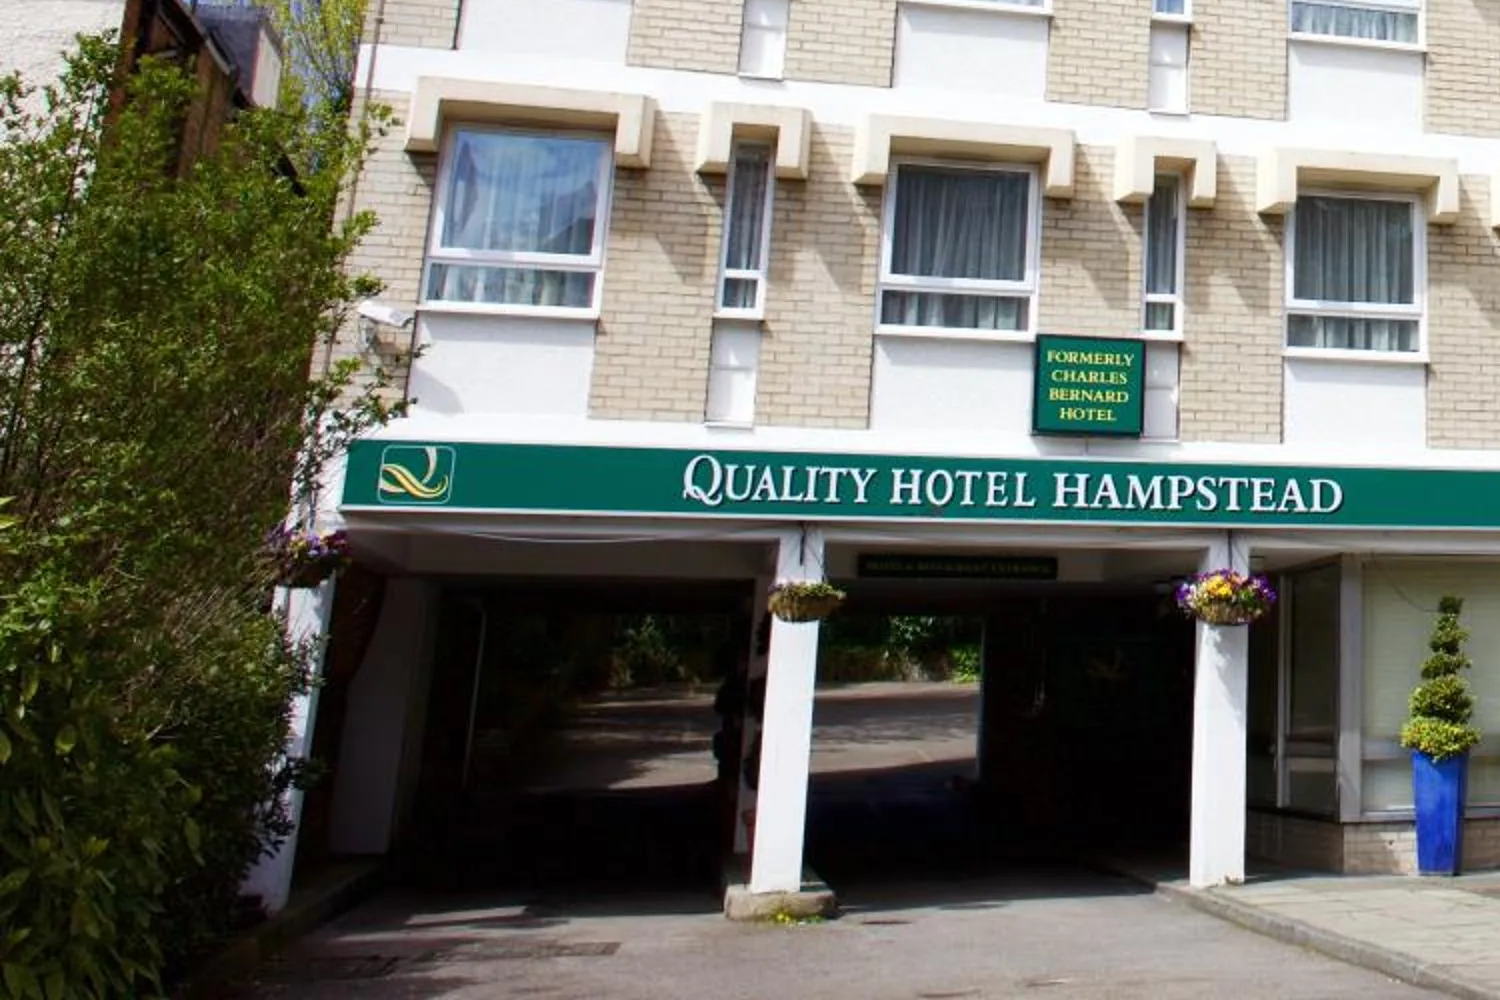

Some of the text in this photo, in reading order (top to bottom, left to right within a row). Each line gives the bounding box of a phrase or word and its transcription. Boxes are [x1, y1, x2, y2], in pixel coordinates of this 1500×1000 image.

[1046, 349, 1135, 367] FORMERLY
[1050, 369, 1128, 385] CHARLES
[1048, 387, 1130, 403] BERNARD
[1059, 406, 1118, 422] HOTEL
[683, 454, 1344, 513] QUALITY HOTEL HAMPSTEAD
